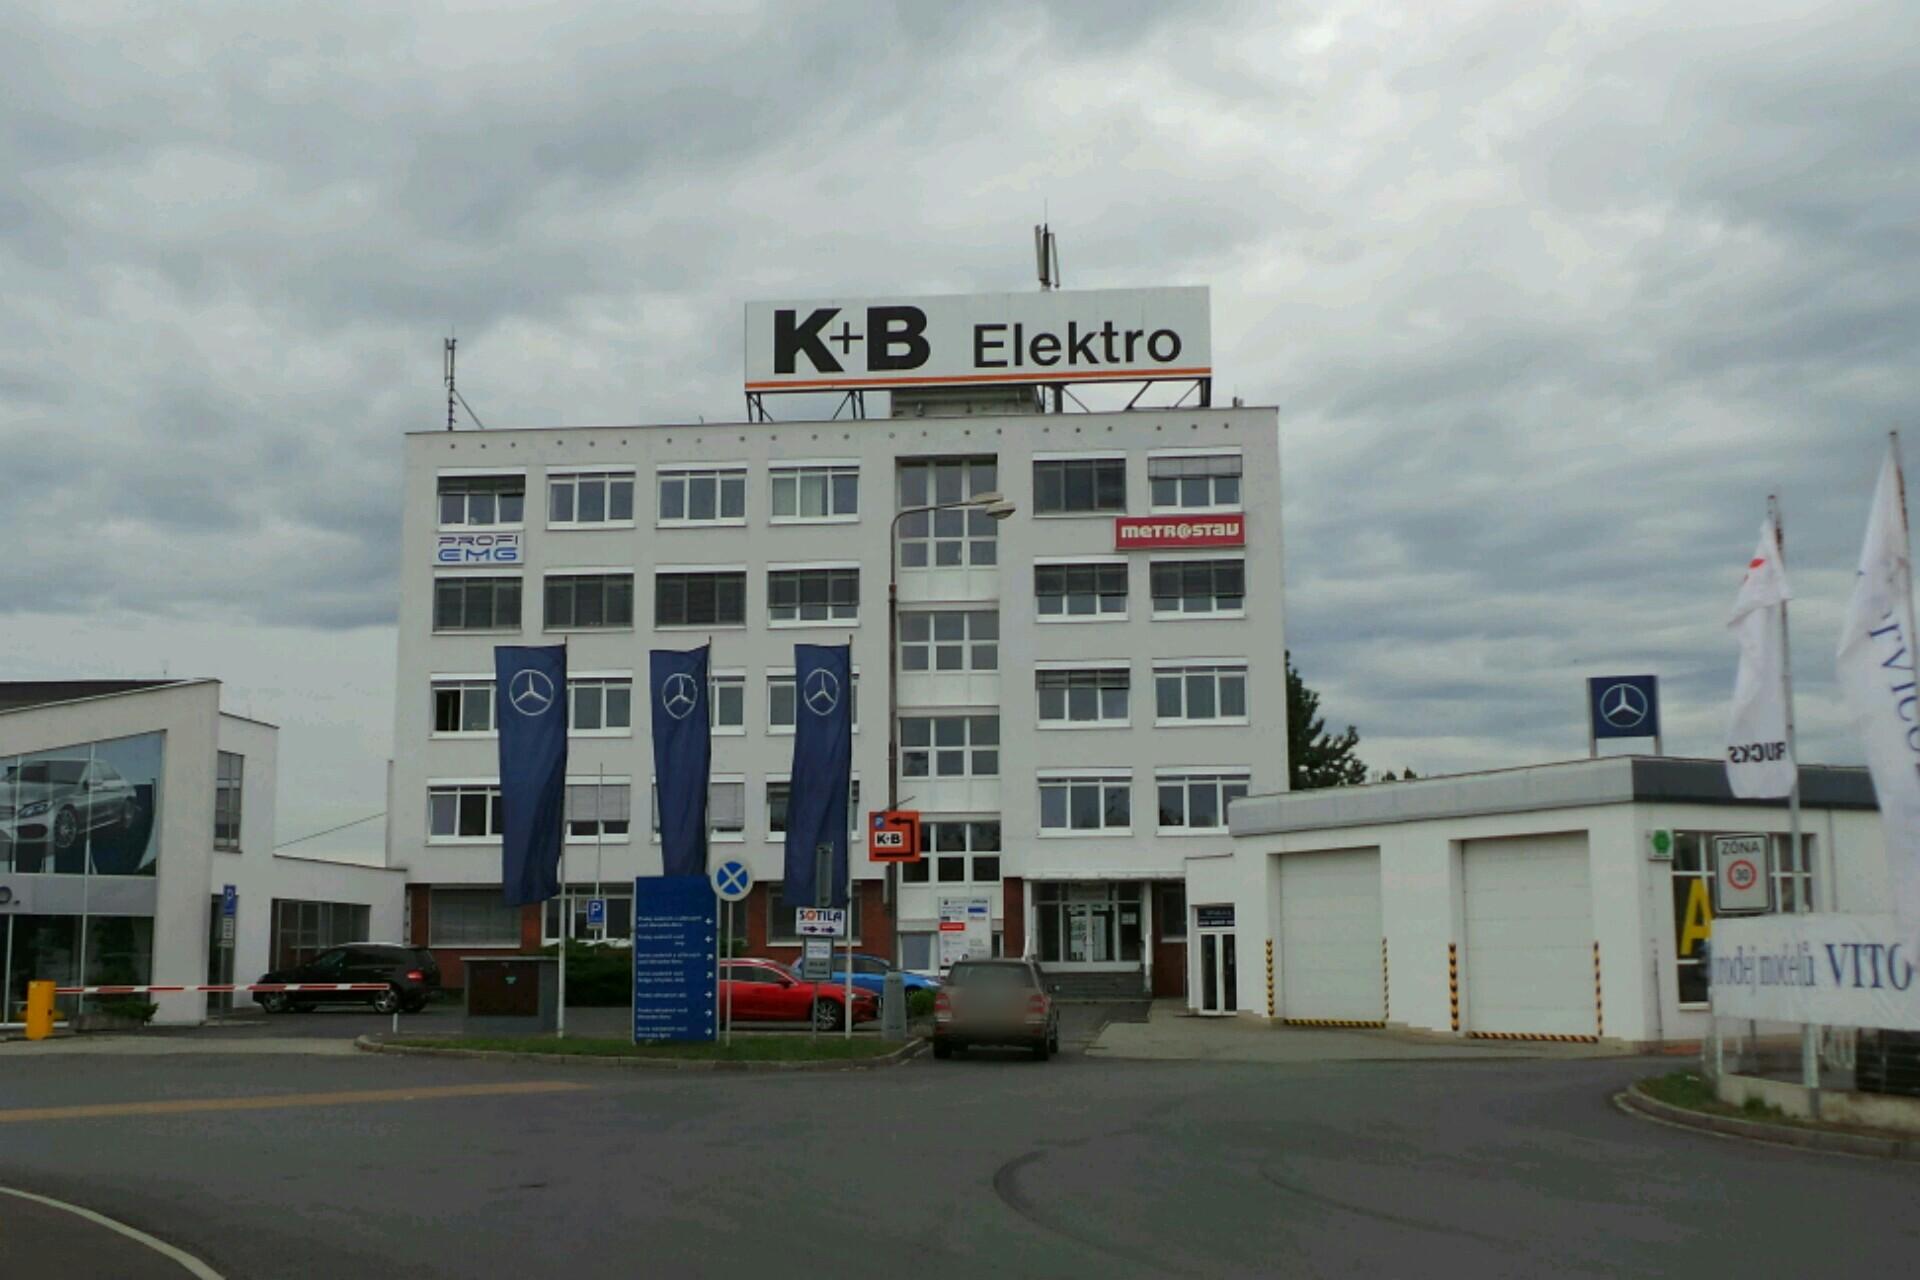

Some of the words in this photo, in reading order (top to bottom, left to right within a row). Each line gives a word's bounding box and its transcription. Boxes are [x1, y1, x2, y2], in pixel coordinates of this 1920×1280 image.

[773, 305, 931, 374] K+B
[973, 320, 1182, 368] Elektro
[438, 534, 519, 547] PROFI
[1735, 868, 1750, 882] 30
[799, 910, 842, 922] SOTILA
